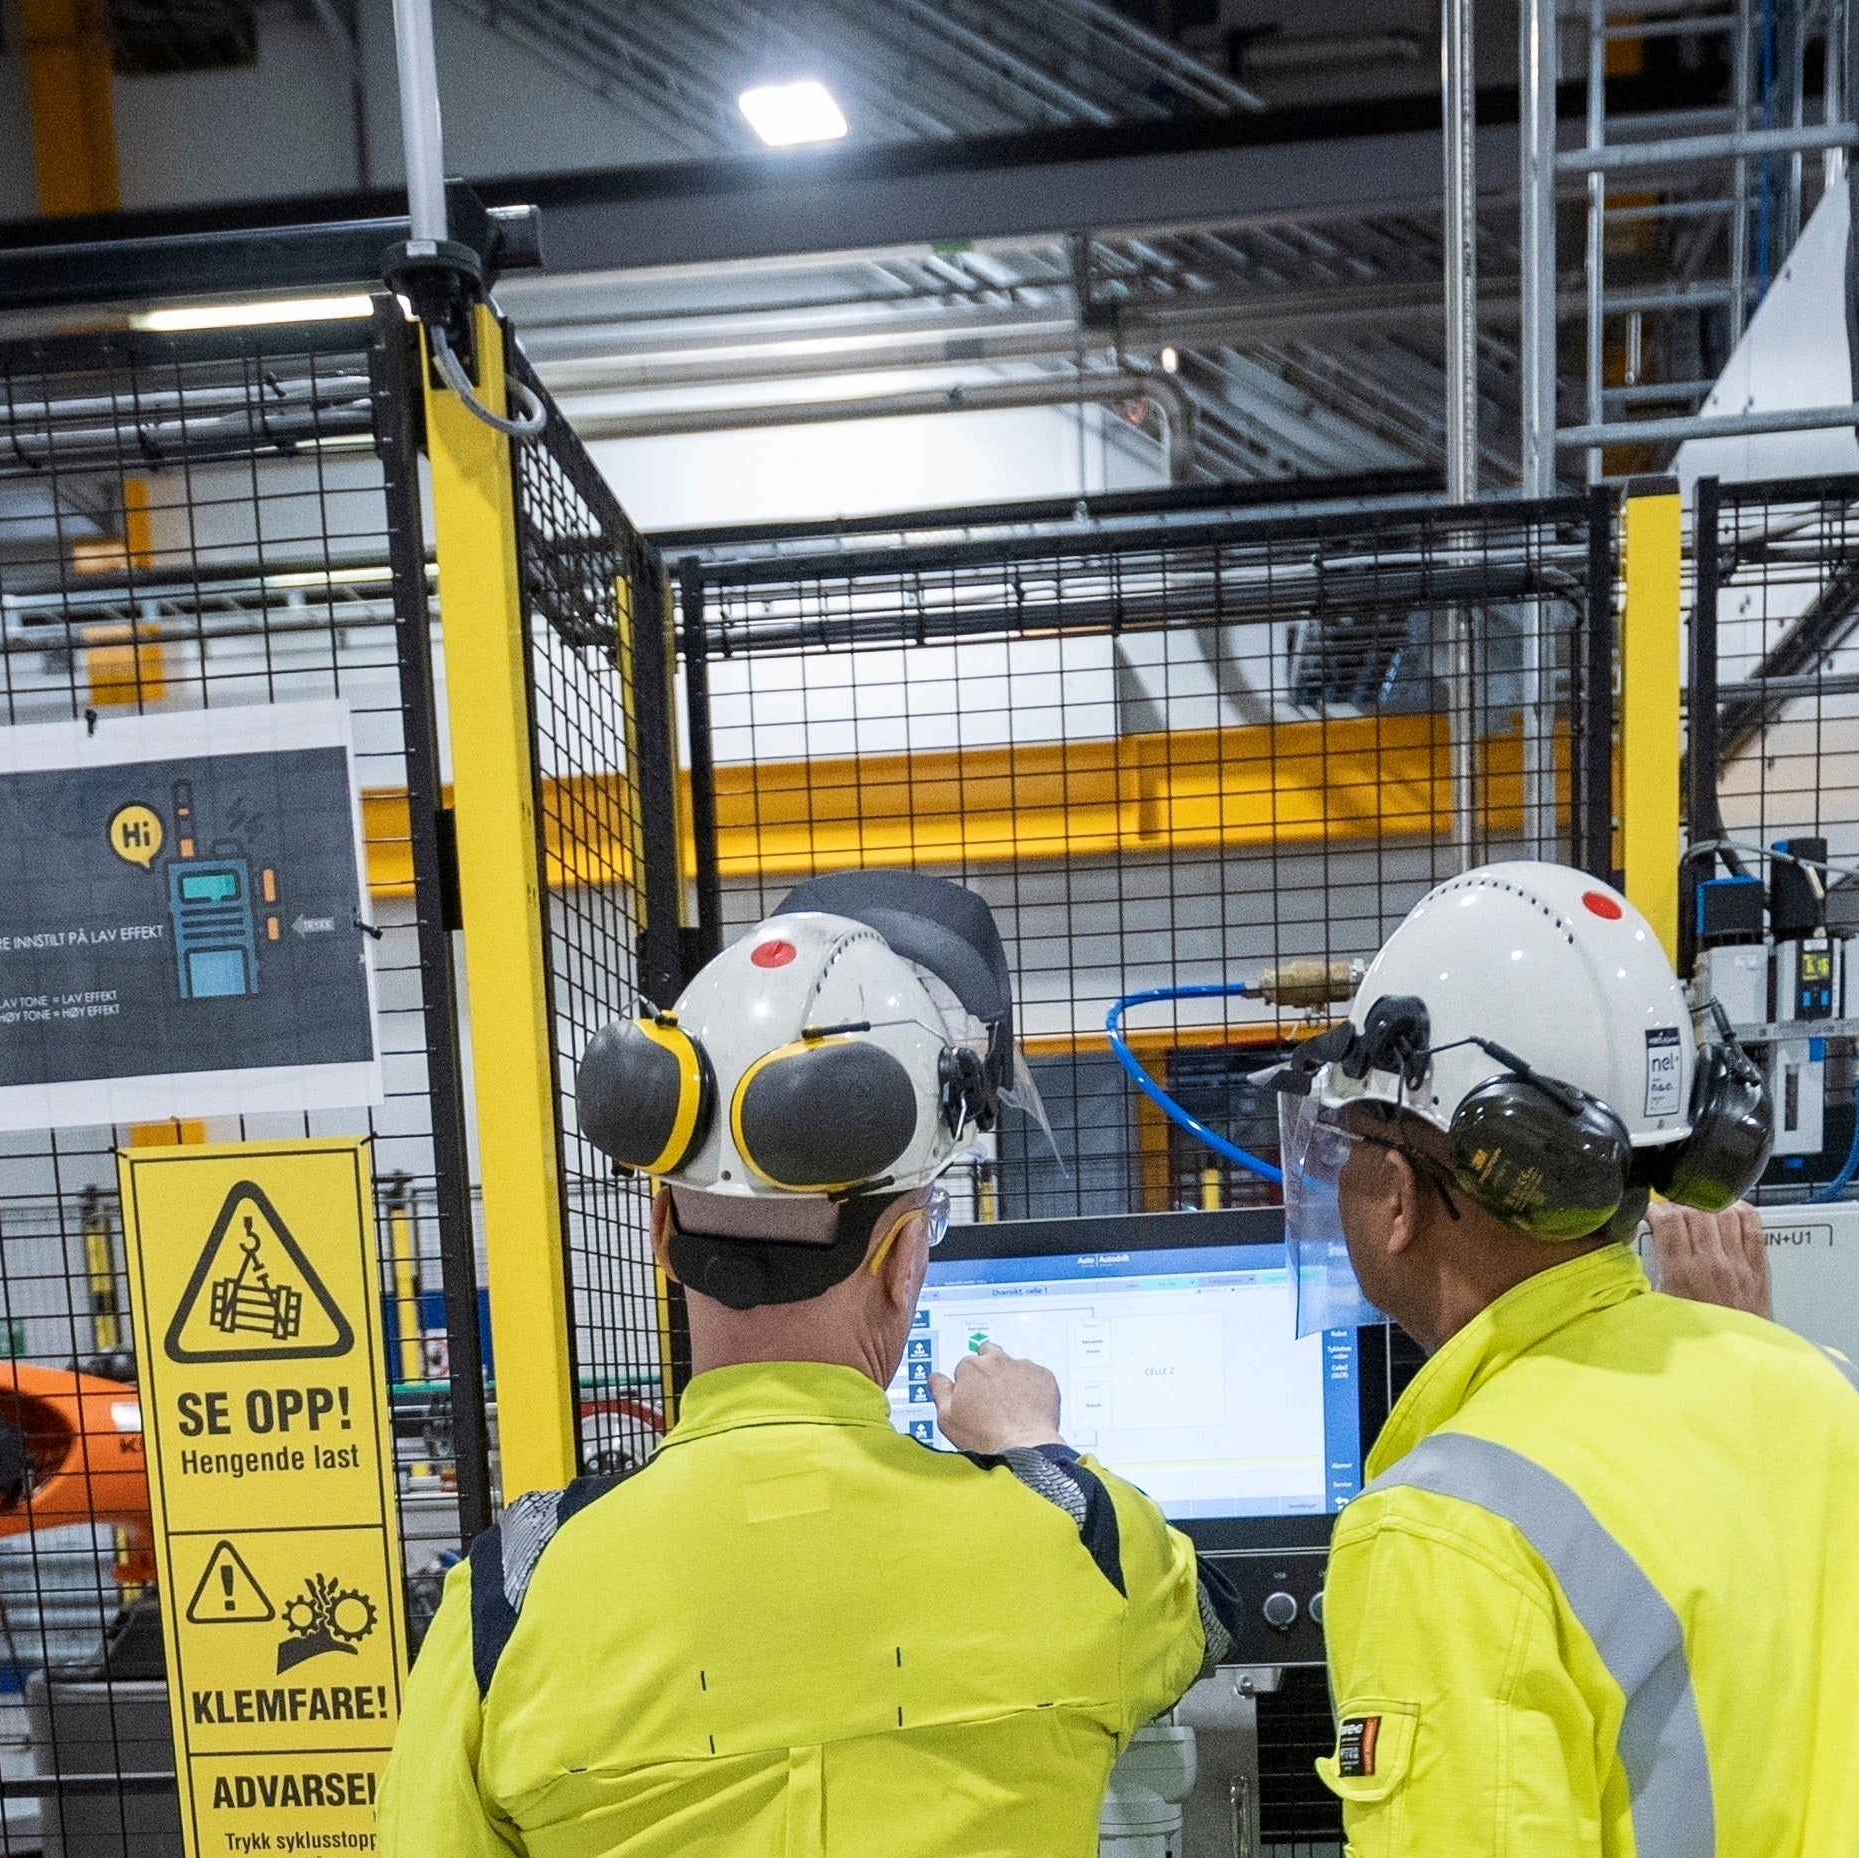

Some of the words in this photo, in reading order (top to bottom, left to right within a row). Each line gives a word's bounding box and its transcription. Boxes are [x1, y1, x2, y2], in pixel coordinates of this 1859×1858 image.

[121, 820, 151, 848] Hi
[13, 932, 67, 950] INNSTILT
[68, 927, 89, 945] PÅ
[91, 928, 118, 944] LAV
[119, 924, 164, 941] EFFEKT
[84, 989, 118, 1002] EFFEKT
[23, 1008, 51, 1021] TONE
[87, 1003, 121, 1017] EFFEKT
[1144, 1367, 1169, 1377] CELLE
[176, 1391, 232, 1438] SE
[245, 1386, 352, 1435] OPP!
[180, 1445, 306, 1479] Hengende
[314, 1443, 361, 1470] last
[191, 1685, 388, 1725] KLEMFARE!
[225, 1831, 272, 1855] Trykk
